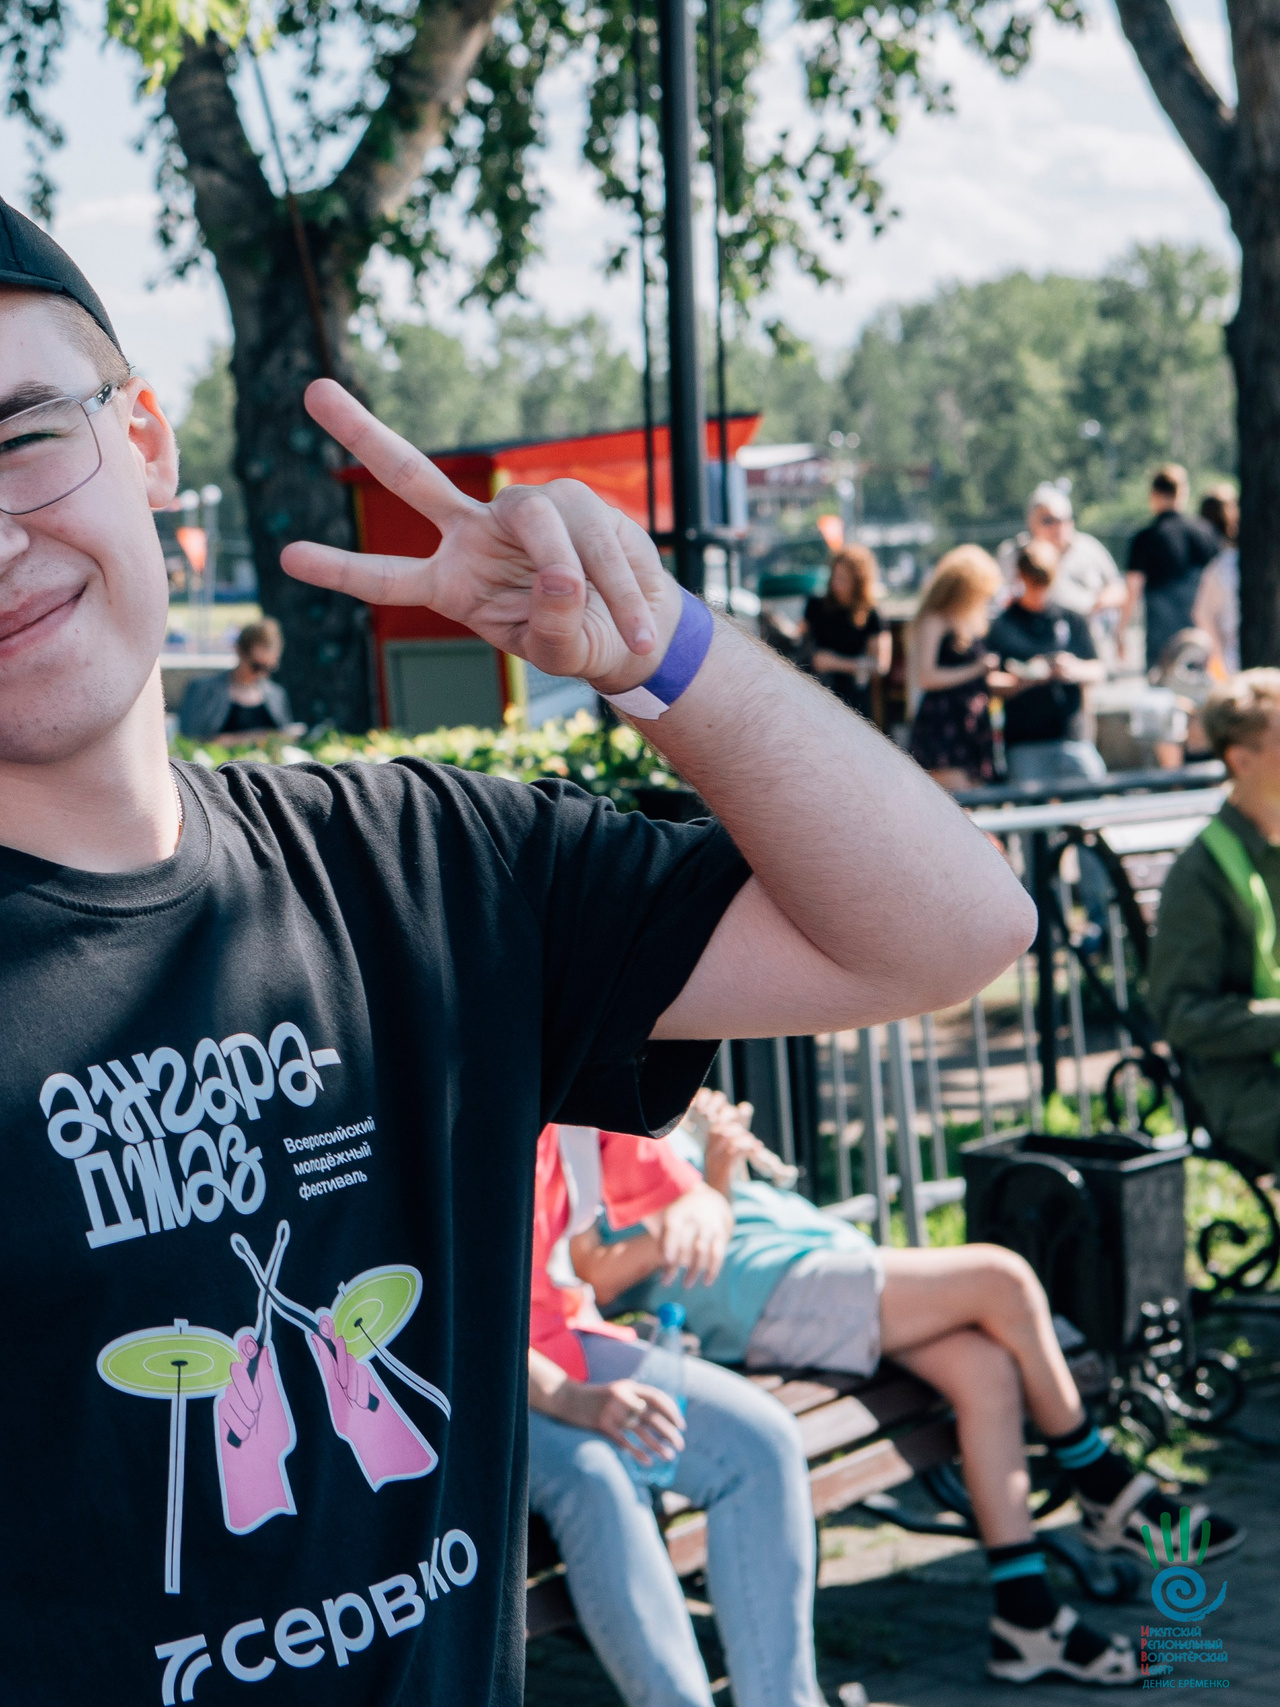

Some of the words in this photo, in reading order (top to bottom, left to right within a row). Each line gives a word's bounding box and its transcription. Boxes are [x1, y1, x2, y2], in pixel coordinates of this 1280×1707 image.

[282, 1115, 376, 1154] Всероссийский
[292, 1140, 372, 1176] молодёжный
[298, 1170, 368, 1201] фестиваль
